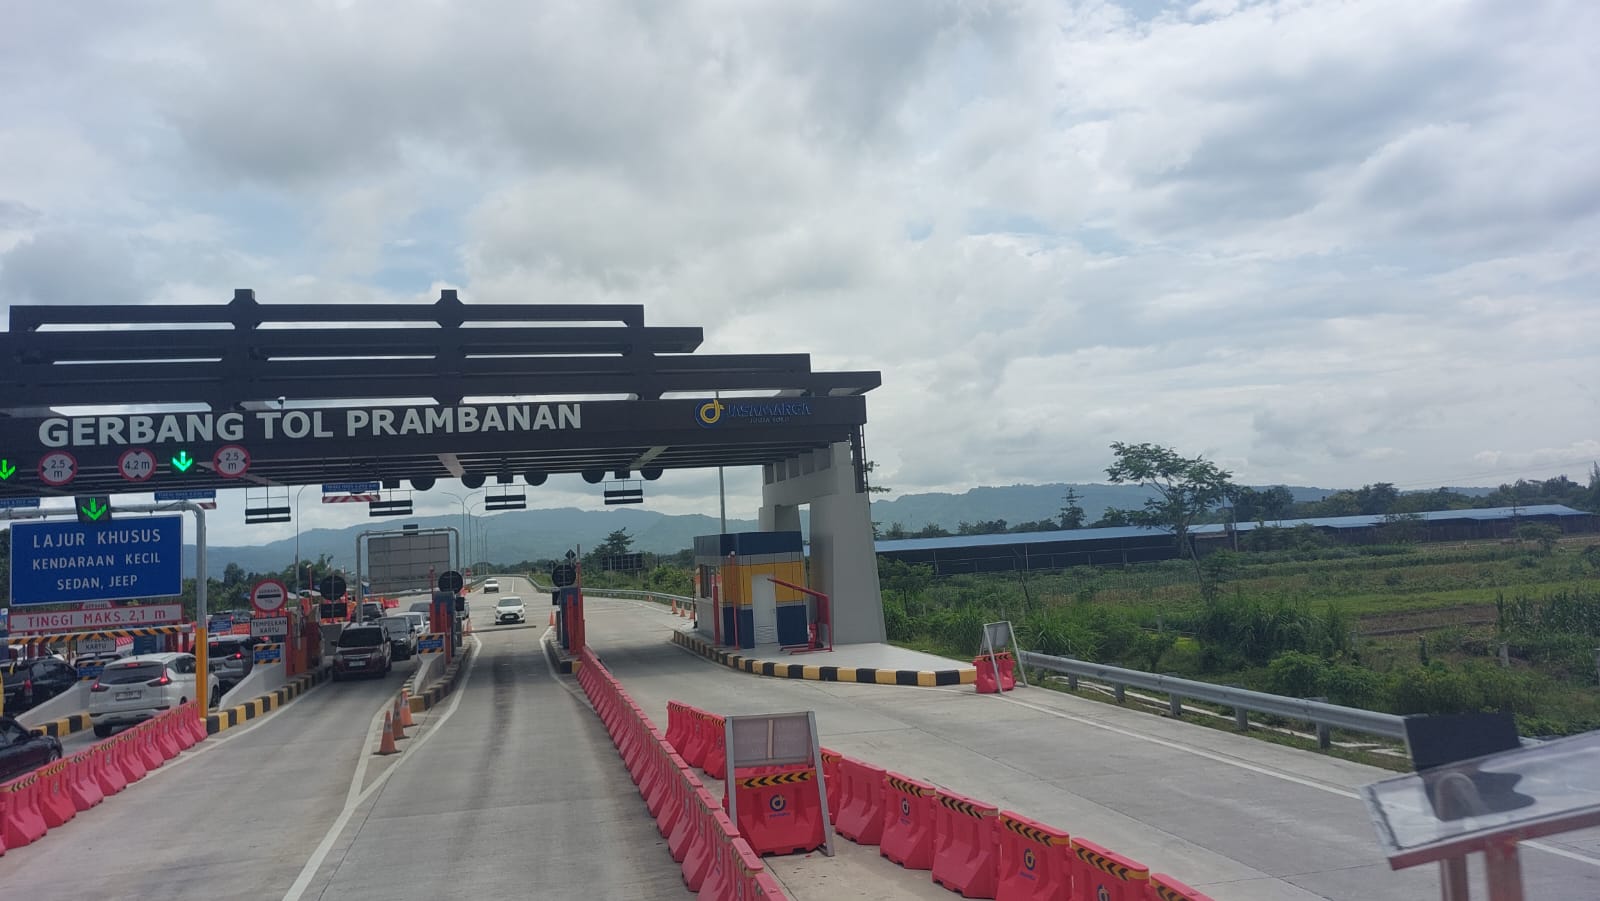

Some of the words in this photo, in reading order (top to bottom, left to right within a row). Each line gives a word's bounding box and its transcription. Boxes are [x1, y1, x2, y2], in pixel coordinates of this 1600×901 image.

[38, 412, 244, 447] GERBANG
[256, 410, 333, 440] TOL
[347, 403, 582, 436] PRAMBANAN
[225, 452, 239, 462] 2.5
[51, 459, 65, 469] 2.5
[125, 460, 139, 470] 4.2
[141, 460, 150, 469] m
[228, 462, 237, 470] m
[53, 470, 63, 479] m
[34, 532, 86, 548] LAJUR
[97, 529, 161, 545] KHUSUS
[33, 555, 114, 570] KENDARAAN
[125, 553, 160, 565] KECIL
[57, 577, 104, 591] SEDAN,
[108, 575, 138, 587] JEEP
[28, 615, 73, 627] TINGGI
[84, 611, 125, 624] MAKS.
[155, 609, 166, 619] m
